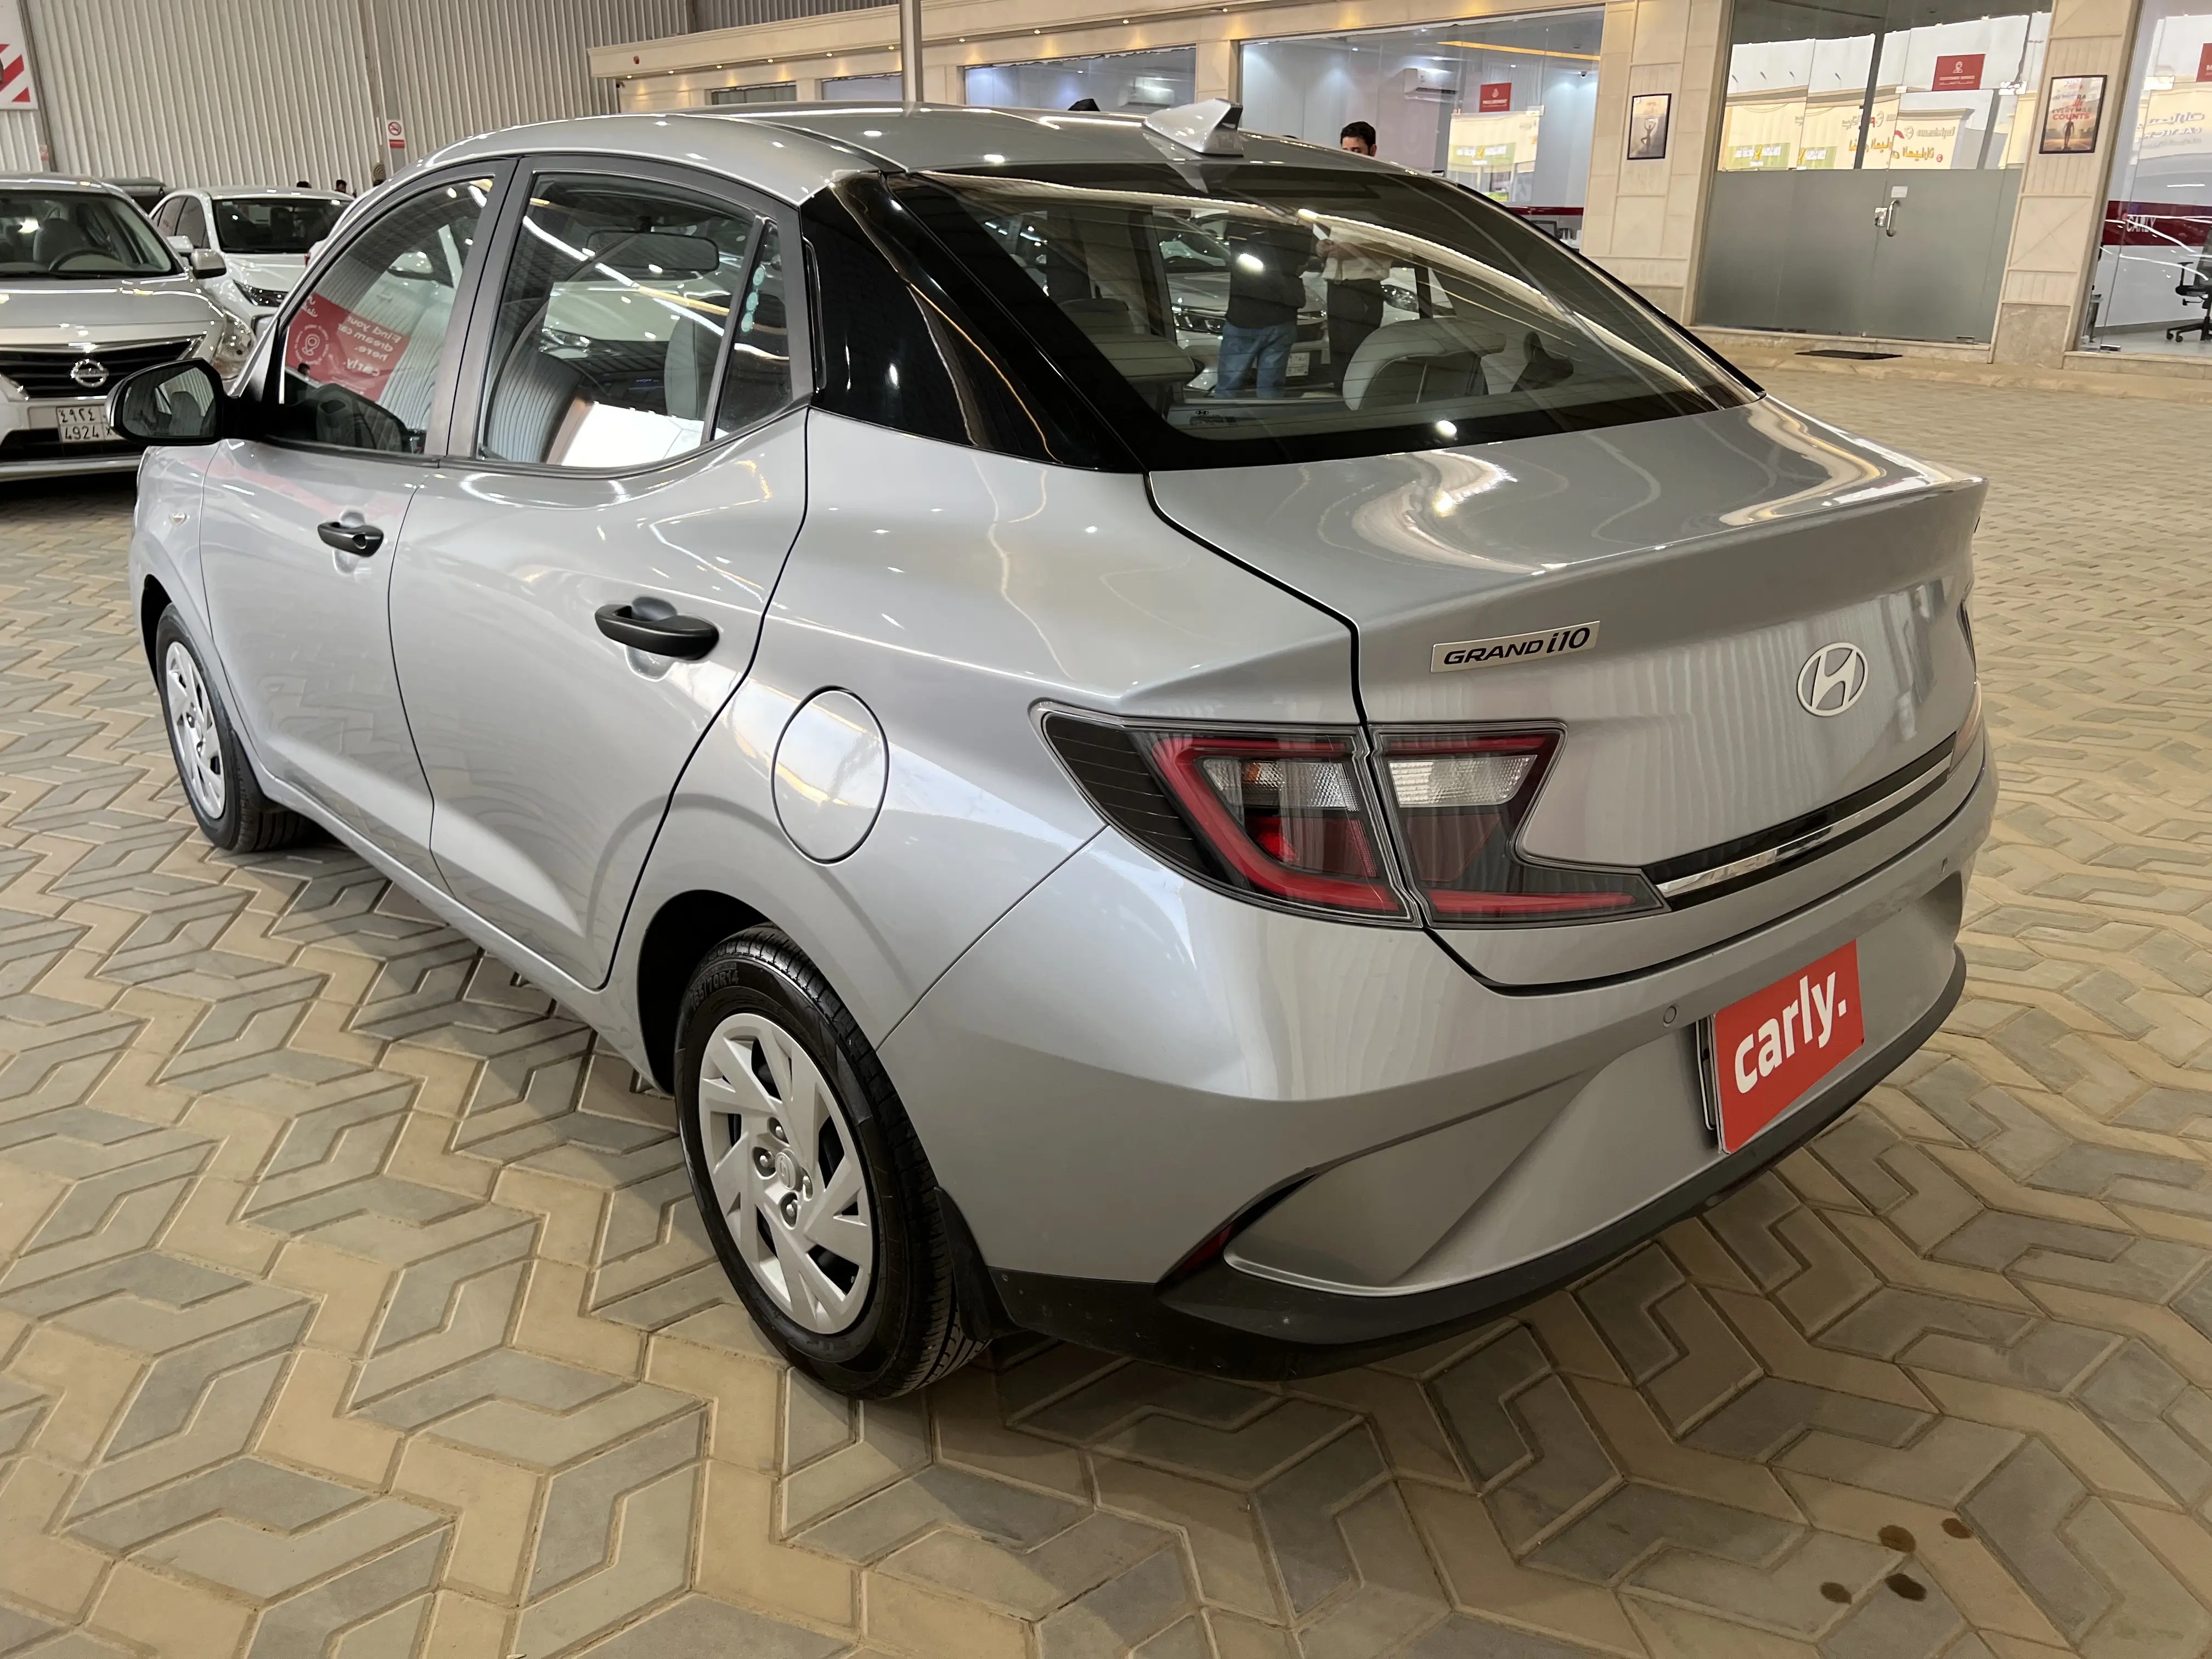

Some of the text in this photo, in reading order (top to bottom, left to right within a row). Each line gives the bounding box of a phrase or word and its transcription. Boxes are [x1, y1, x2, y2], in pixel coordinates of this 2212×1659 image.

[65, 425, 99, 439] 4924
[1443, 627, 1590, 665] GRAND i10
[1734, 971, 1847, 1094] carly.
